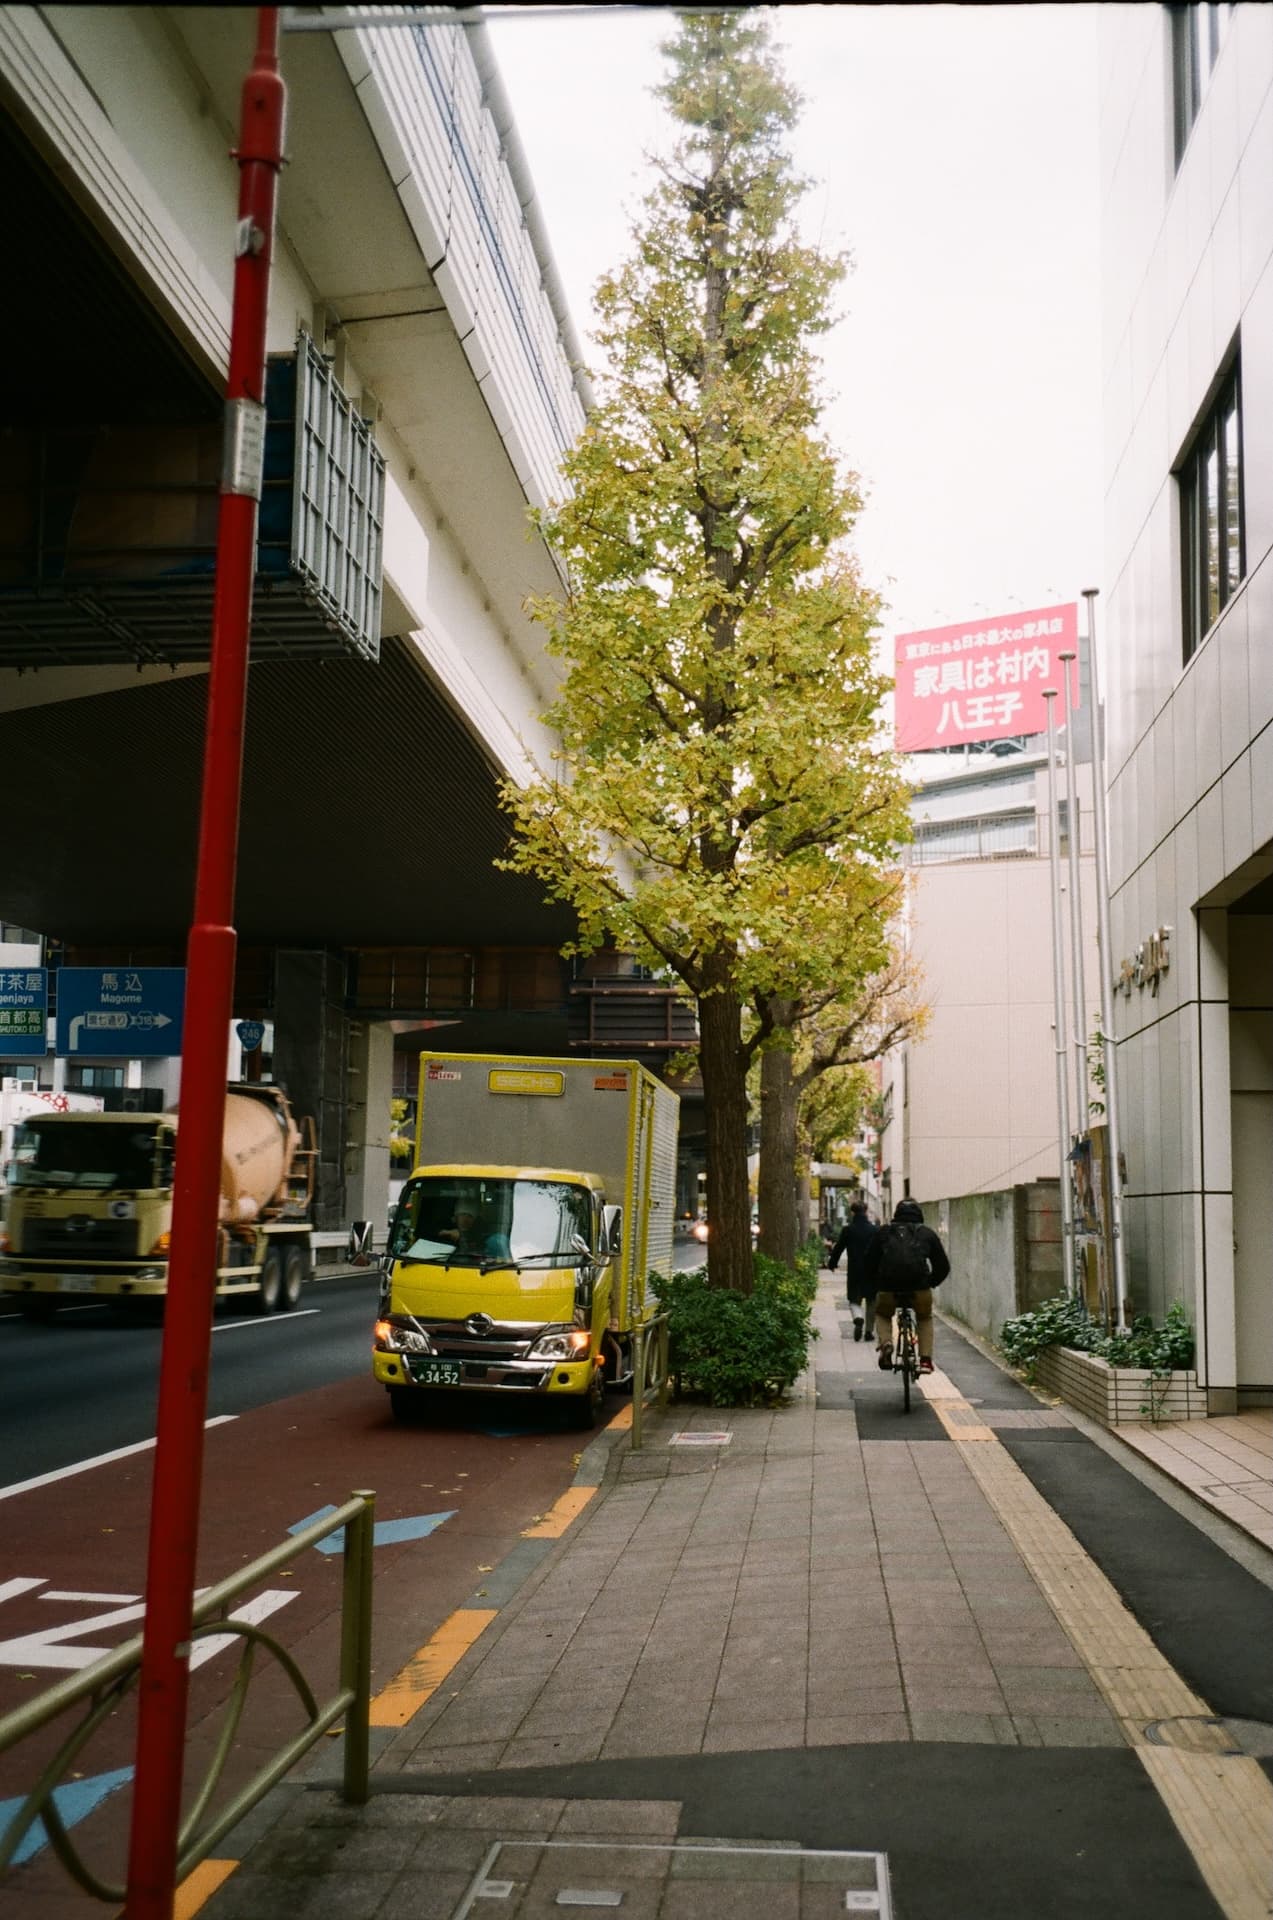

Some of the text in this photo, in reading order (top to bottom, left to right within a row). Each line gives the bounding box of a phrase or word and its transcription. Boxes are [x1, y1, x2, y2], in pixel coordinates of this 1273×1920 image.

[905, 617, 1063, 660] 東京にある日本最大の家具店
[913, 646, 1050, 697] 家具は村内
[936, 691, 1024, 734] 八王子
[101, 972, 143, 991] 馬込
[100, 993, 142, 1005] Magome
[0, 1010, 41, 1024] 首都高
[241, 1028, 260, 1040] 246
[425, 1370, 459, 1385] 34-52
